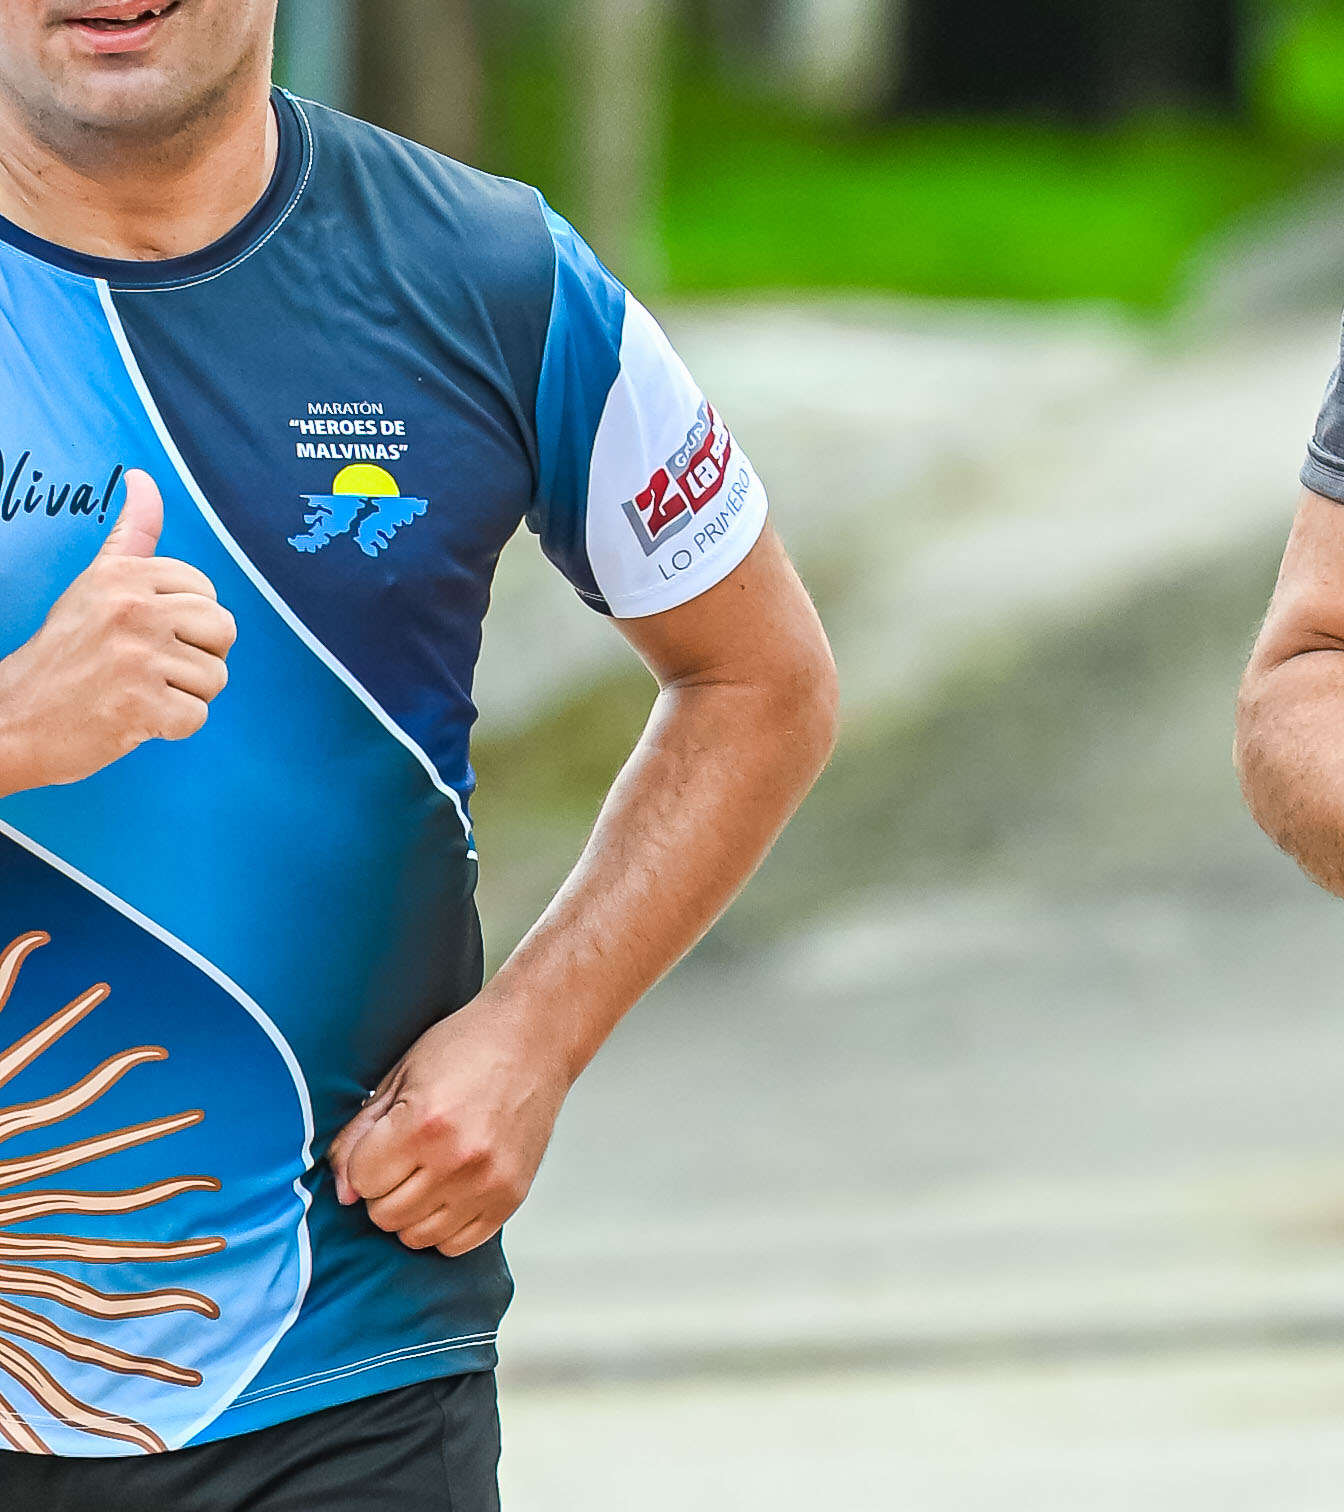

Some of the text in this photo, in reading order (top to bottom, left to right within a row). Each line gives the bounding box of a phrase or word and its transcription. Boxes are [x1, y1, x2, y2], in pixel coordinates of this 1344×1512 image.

[307, 400, 384, 415] MARATÓN
[288, 419, 406, 436] “HEROES DE
[296, 442, 409, 461] MALVINAS”
[658, 549, 692, 581] LO
[694, 468, 750, 554] PRIMERO
